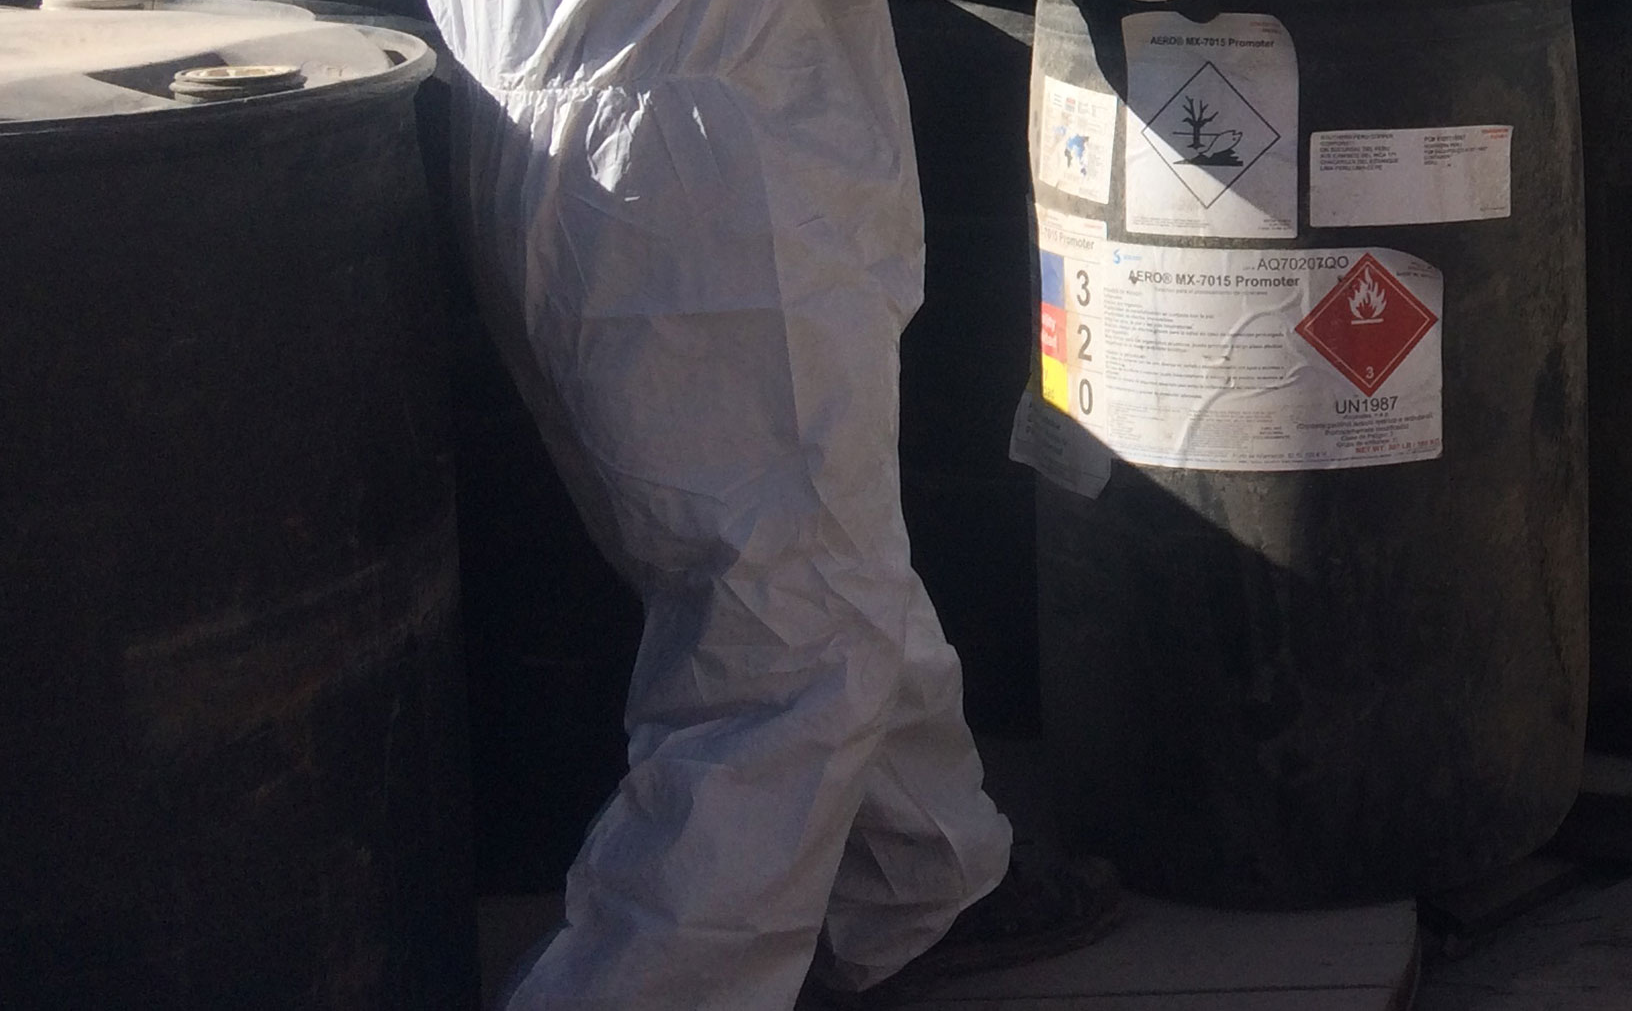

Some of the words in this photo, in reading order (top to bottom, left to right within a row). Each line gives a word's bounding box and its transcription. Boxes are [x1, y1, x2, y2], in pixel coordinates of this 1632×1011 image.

[1186, 37, 1226, 47] MX-7015
[1229, 38, 1274, 48] Promoter
[1076, 270, 1091, 306] 3
[1128, 270, 1173, 284] AERO®
[1175, 274, 1232, 287] MX-7015
[1235, 275, 1300, 288] Promoter
[1077, 324, 1093, 361] 2
[1365, 366, 1374, 380] 3
[1079, 378, 1094, 415] 0
[1335, 396, 1398, 414] UN1987
